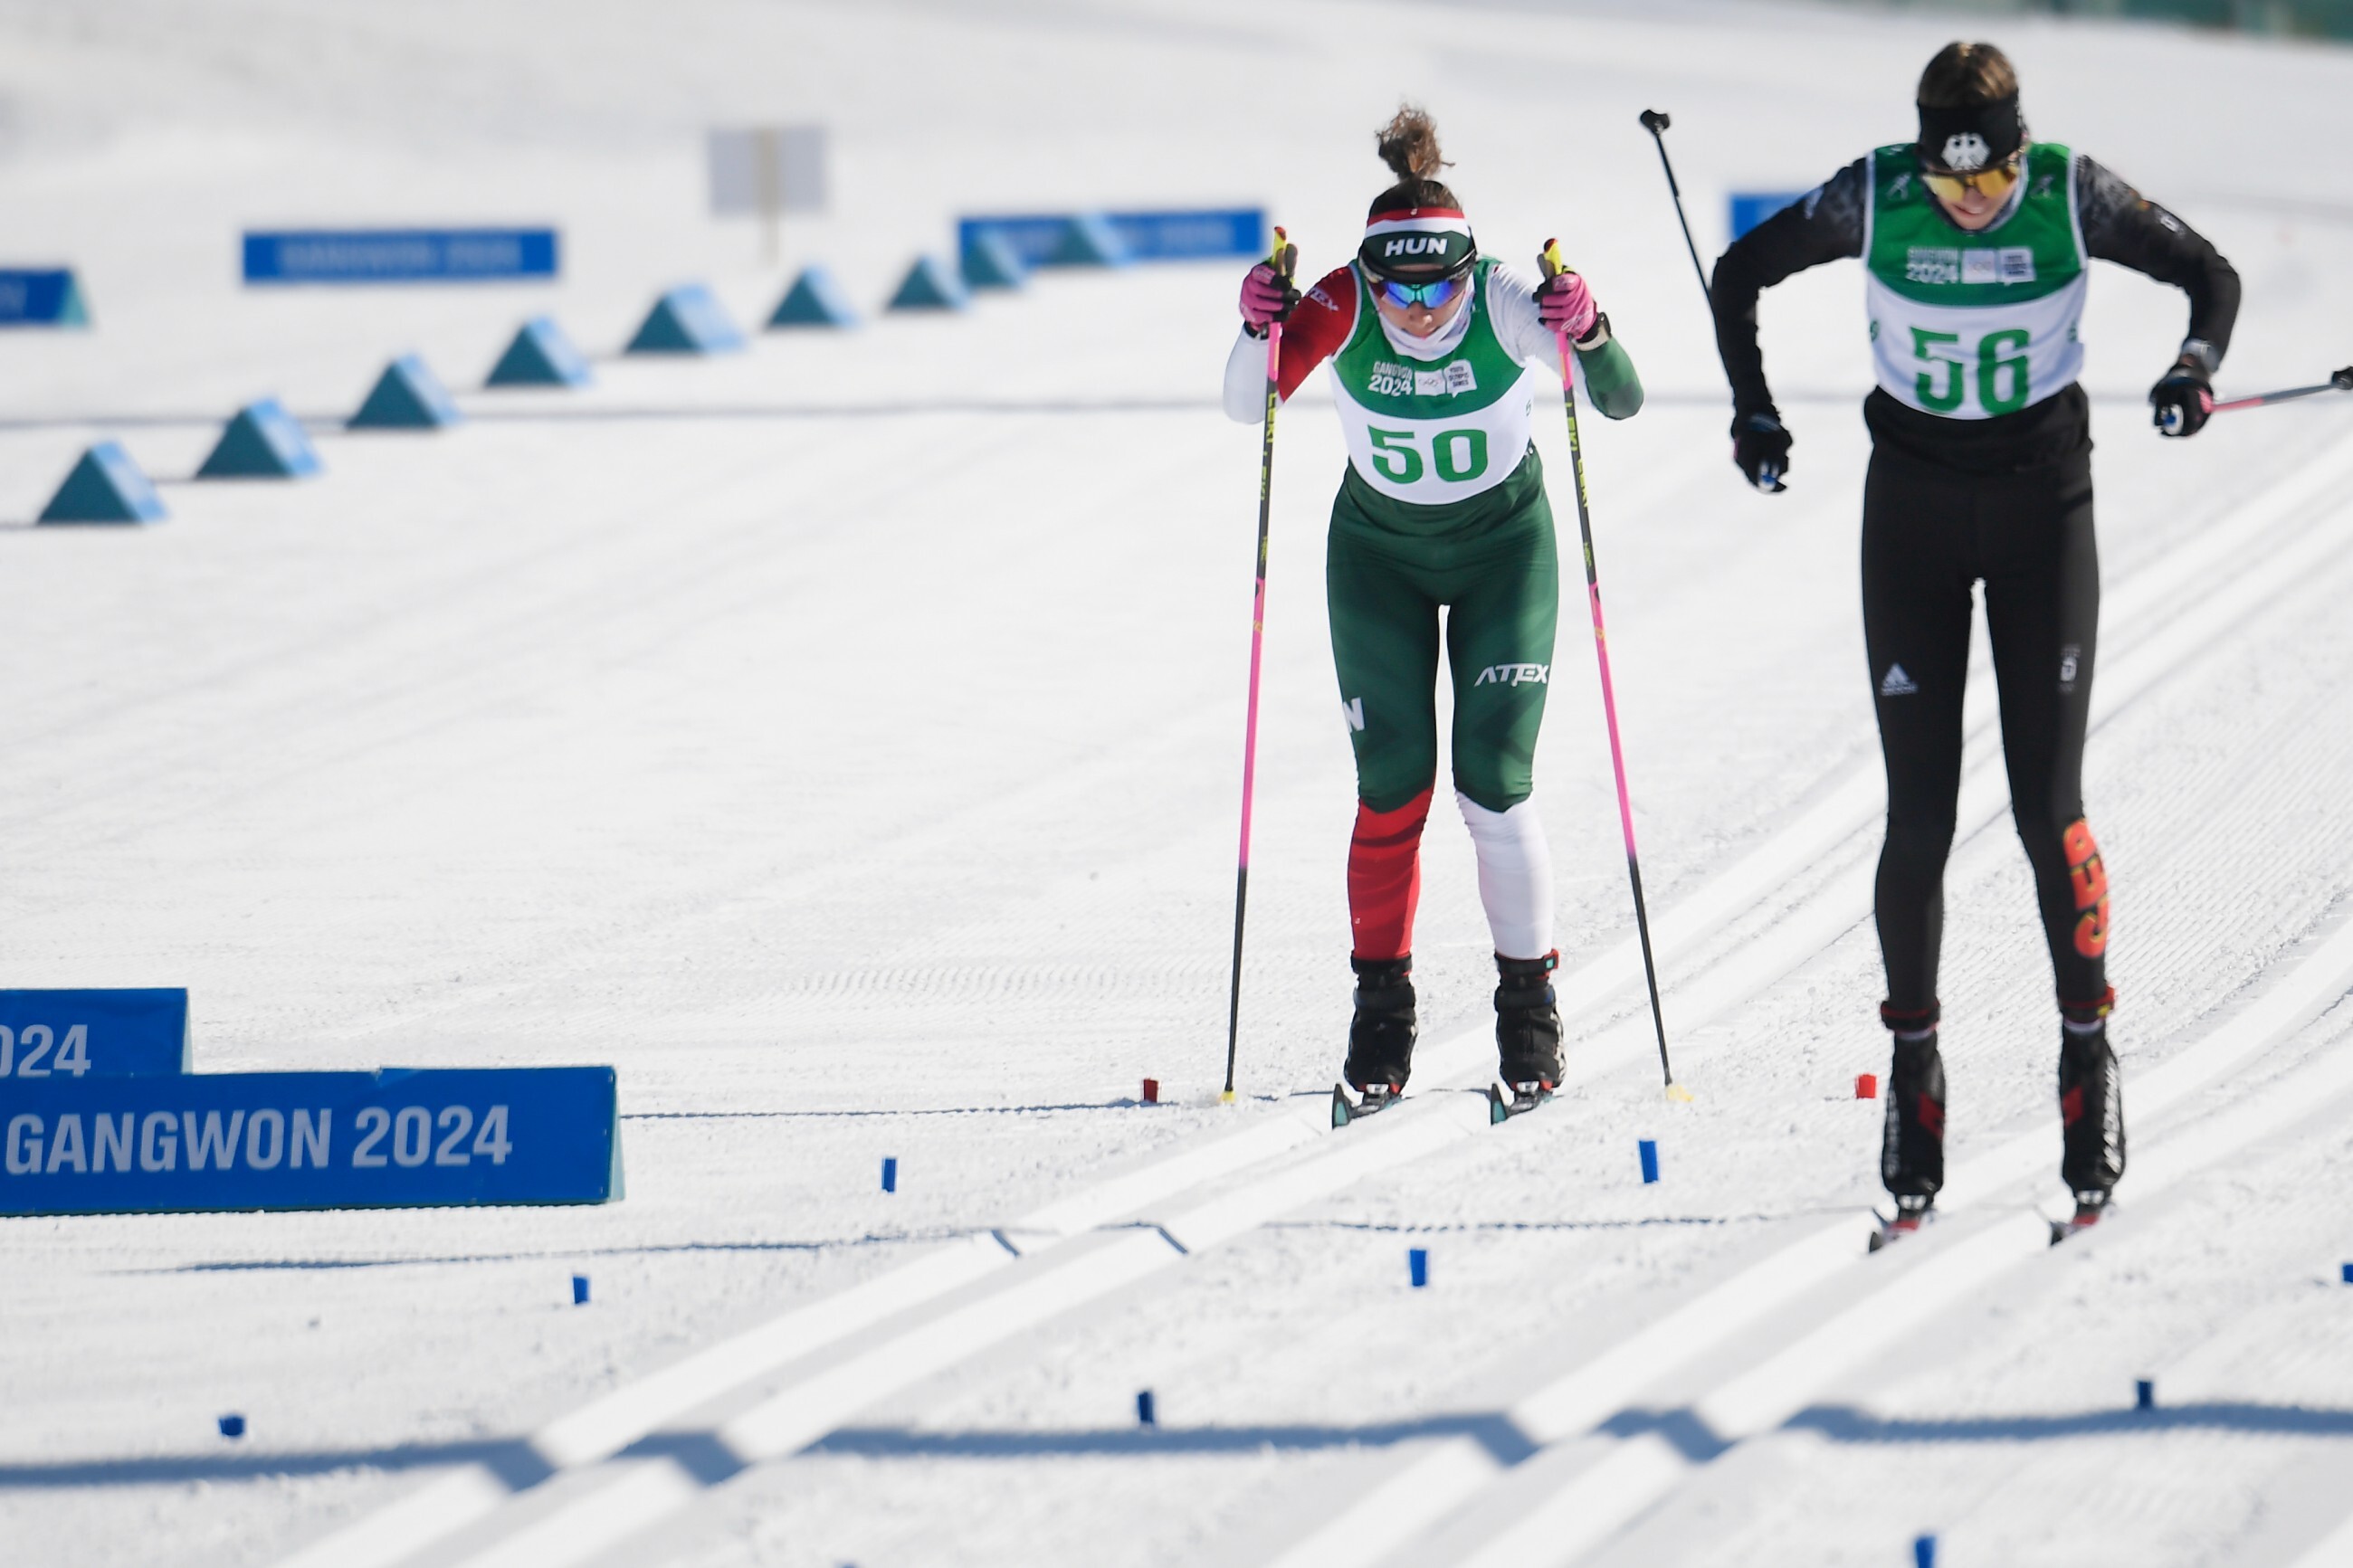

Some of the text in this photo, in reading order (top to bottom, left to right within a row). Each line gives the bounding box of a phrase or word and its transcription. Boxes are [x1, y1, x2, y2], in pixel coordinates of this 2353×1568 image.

[1385, 237, 1448, 257] HUN
[1367, 374, 1413, 396] 2024
[1910, 327, 2030, 417] 56
[1367, 424, 1487, 484] 50
[5, 1105, 512, 1174] GANGWON 2024
